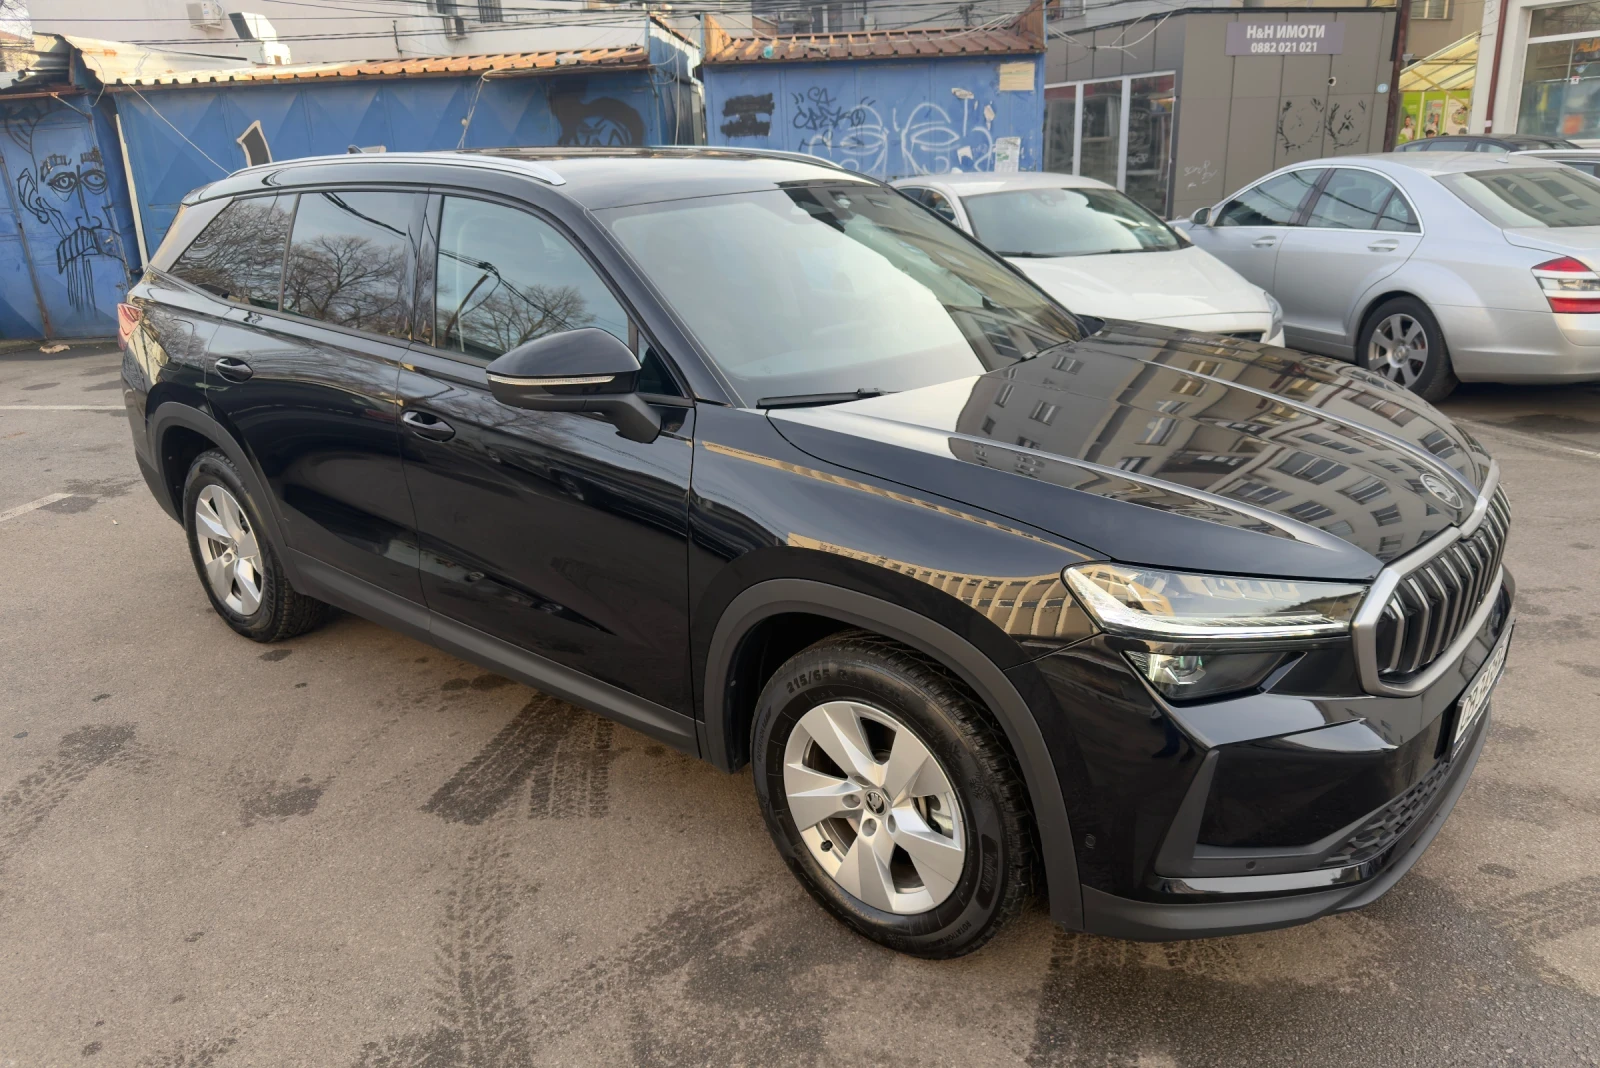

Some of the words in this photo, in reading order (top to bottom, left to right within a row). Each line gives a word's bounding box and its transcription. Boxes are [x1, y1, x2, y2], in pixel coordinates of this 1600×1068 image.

[1276, 24, 1326, 39] ИМОТИ
[1250, 42, 1277, 53] 0882
[1278, 42, 1297, 53] 021
[1299, 42, 1318, 52] 021
[786, 668, 830, 694] 215/65
